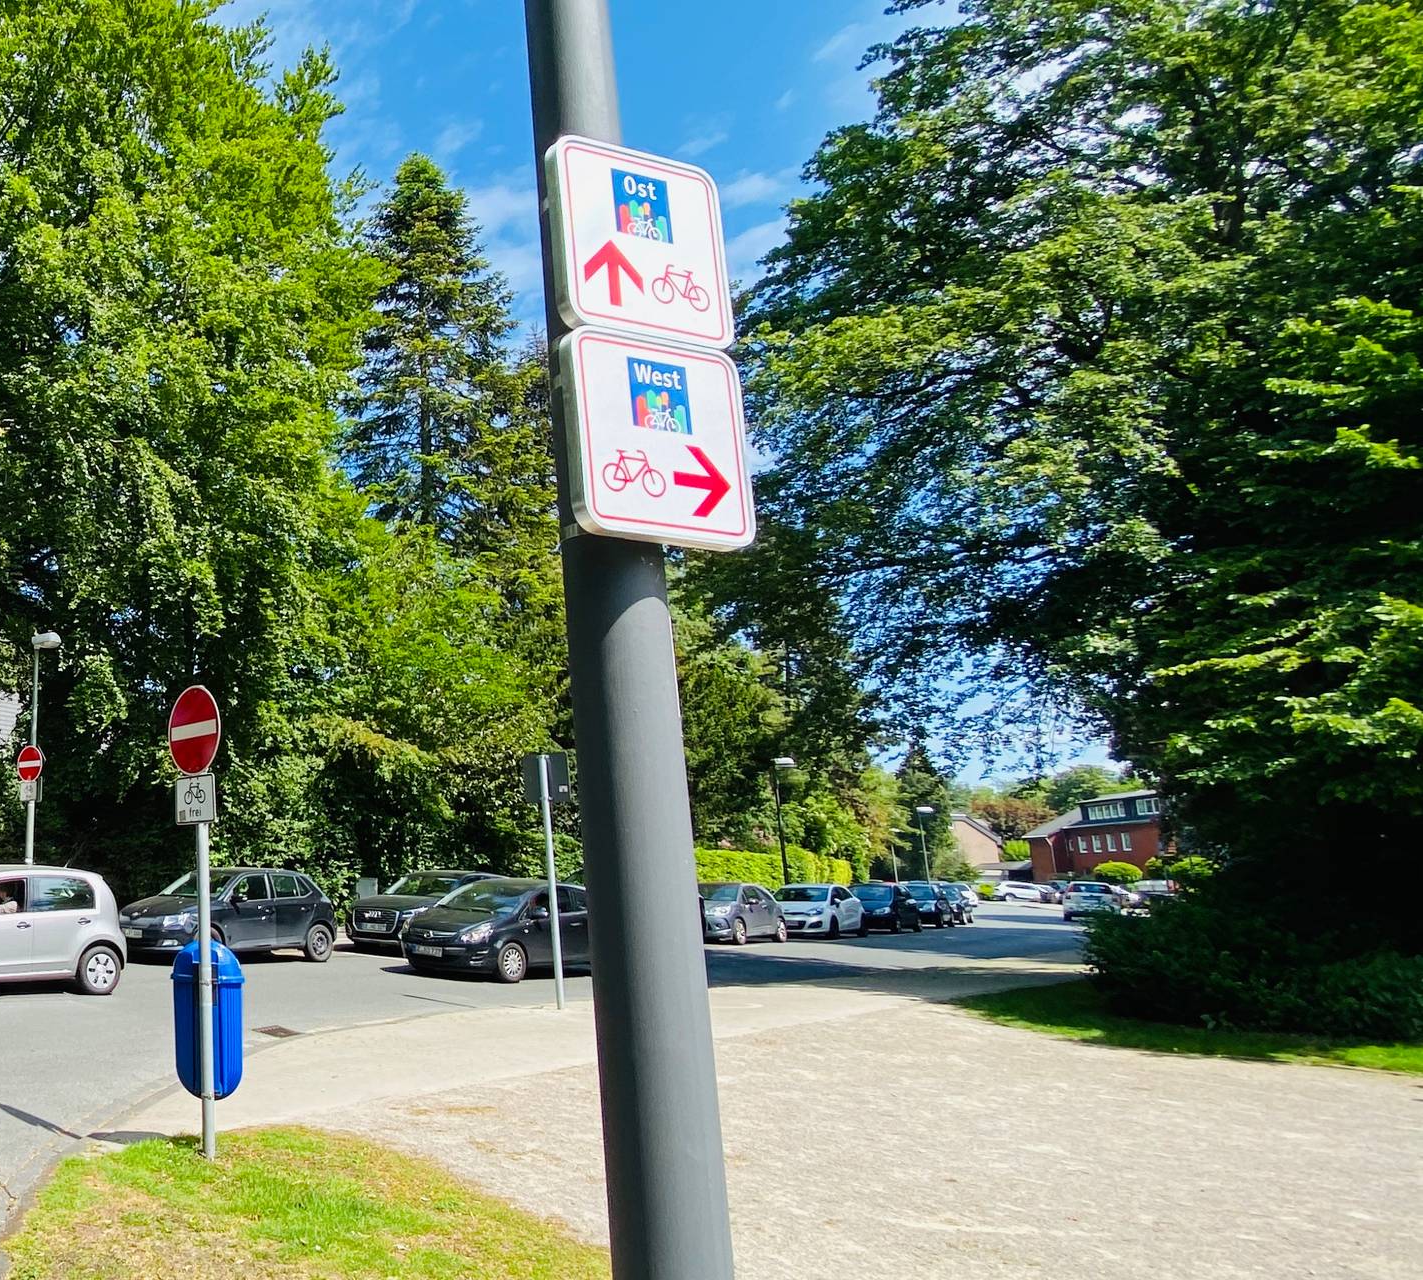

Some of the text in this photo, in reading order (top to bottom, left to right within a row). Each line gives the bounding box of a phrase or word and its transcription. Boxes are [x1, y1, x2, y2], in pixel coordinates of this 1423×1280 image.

[623, 175, 657, 201] Ost
[633, 362, 682, 390] West
[189, 807, 202, 818] frei
